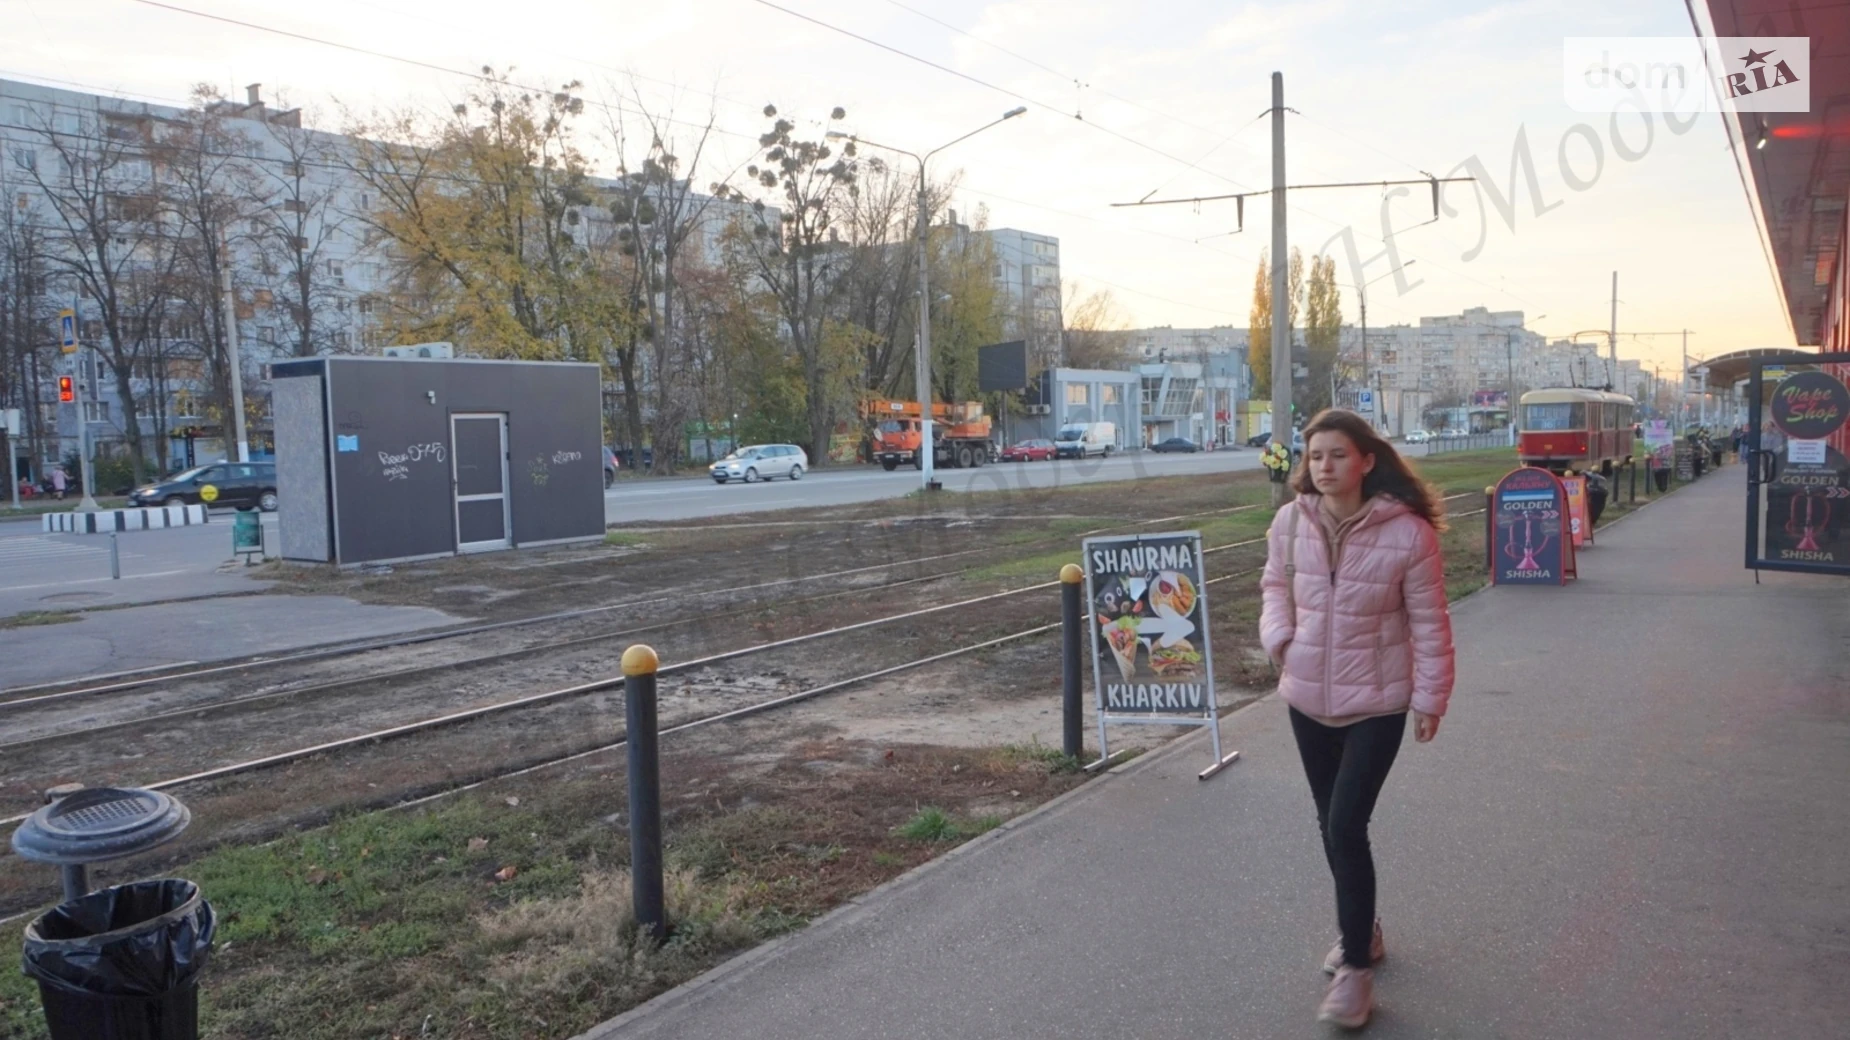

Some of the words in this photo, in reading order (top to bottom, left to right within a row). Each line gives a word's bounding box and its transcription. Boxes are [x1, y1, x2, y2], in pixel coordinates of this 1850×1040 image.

[1786, 401, 1840, 423] Shop
[1780, 475, 1840, 486] GOLDEN
[1503, 500, 1553, 511] GOLDEN
[1092, 544, 1193, 574] SHAURMA
[1780, 549, 1834, 562] SHISHA
[1505, 569, 1551, 579] SHISHA
[1107, 683, 1201, 709] KHARKIV
